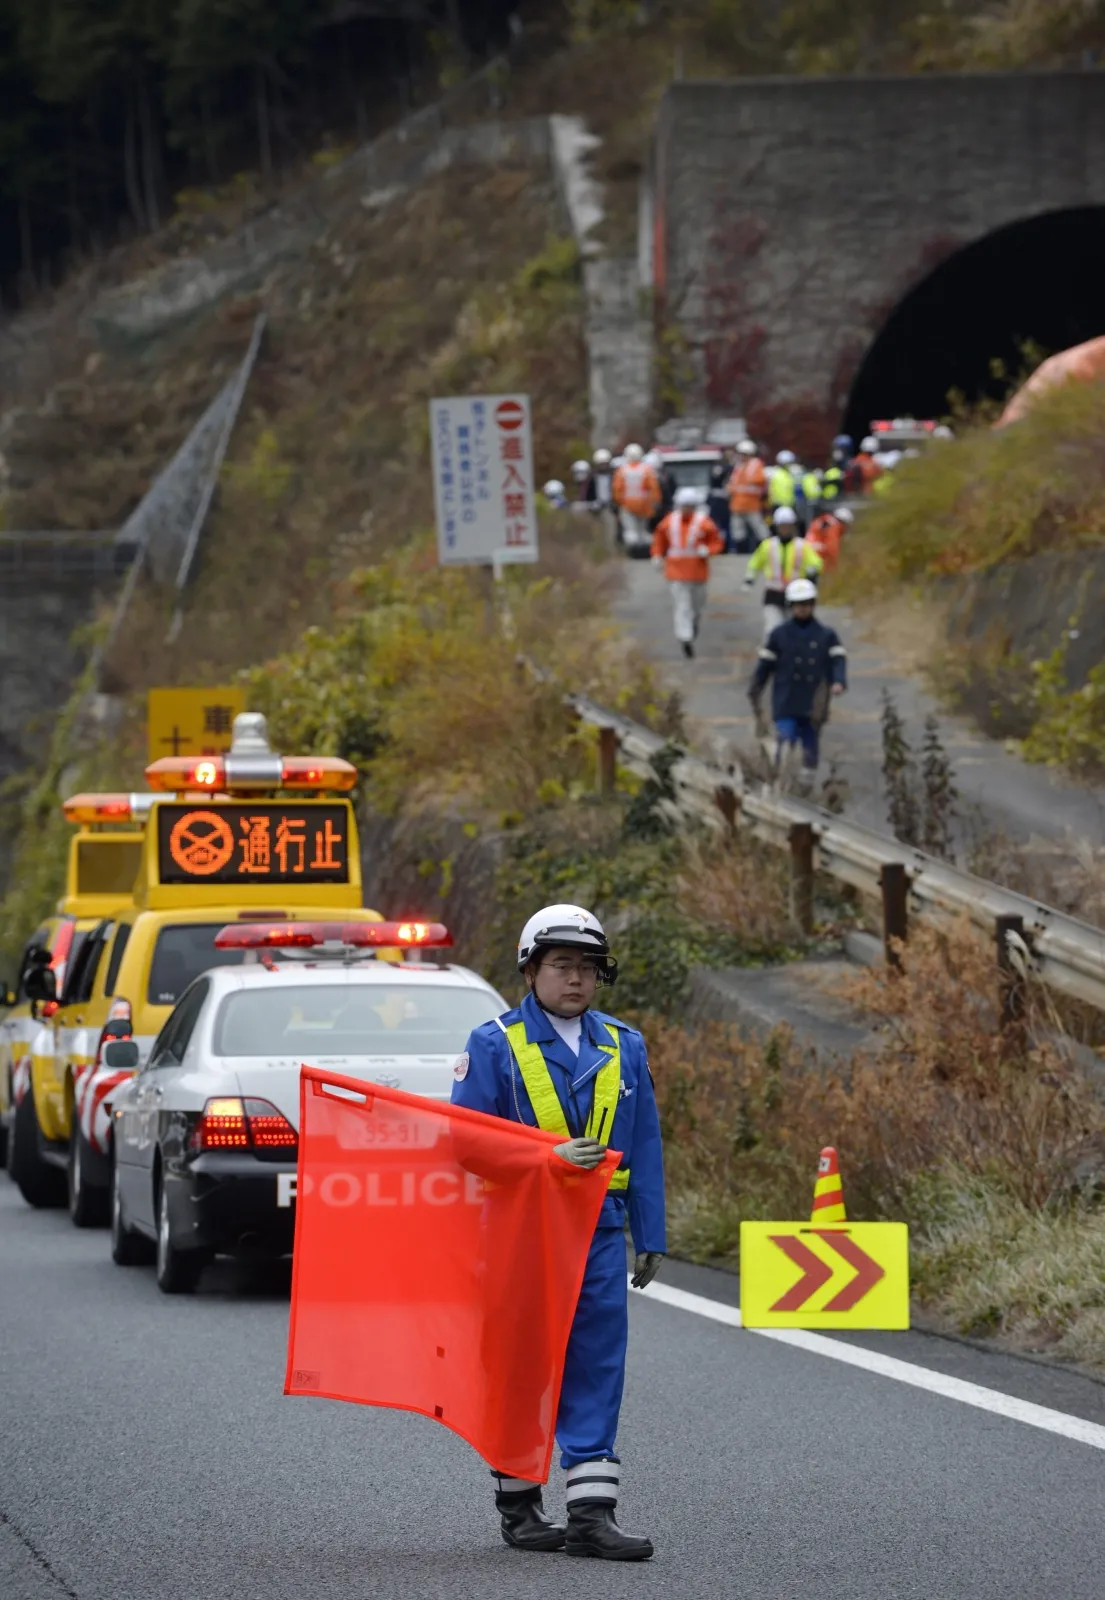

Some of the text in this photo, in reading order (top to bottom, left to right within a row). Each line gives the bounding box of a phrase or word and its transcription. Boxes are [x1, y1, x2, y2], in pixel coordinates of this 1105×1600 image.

[499, 436, 530, 547] 進入禁止
[238, 816, 342, 873] 通行止
[276, 1171, 487, 1208] POLICE
